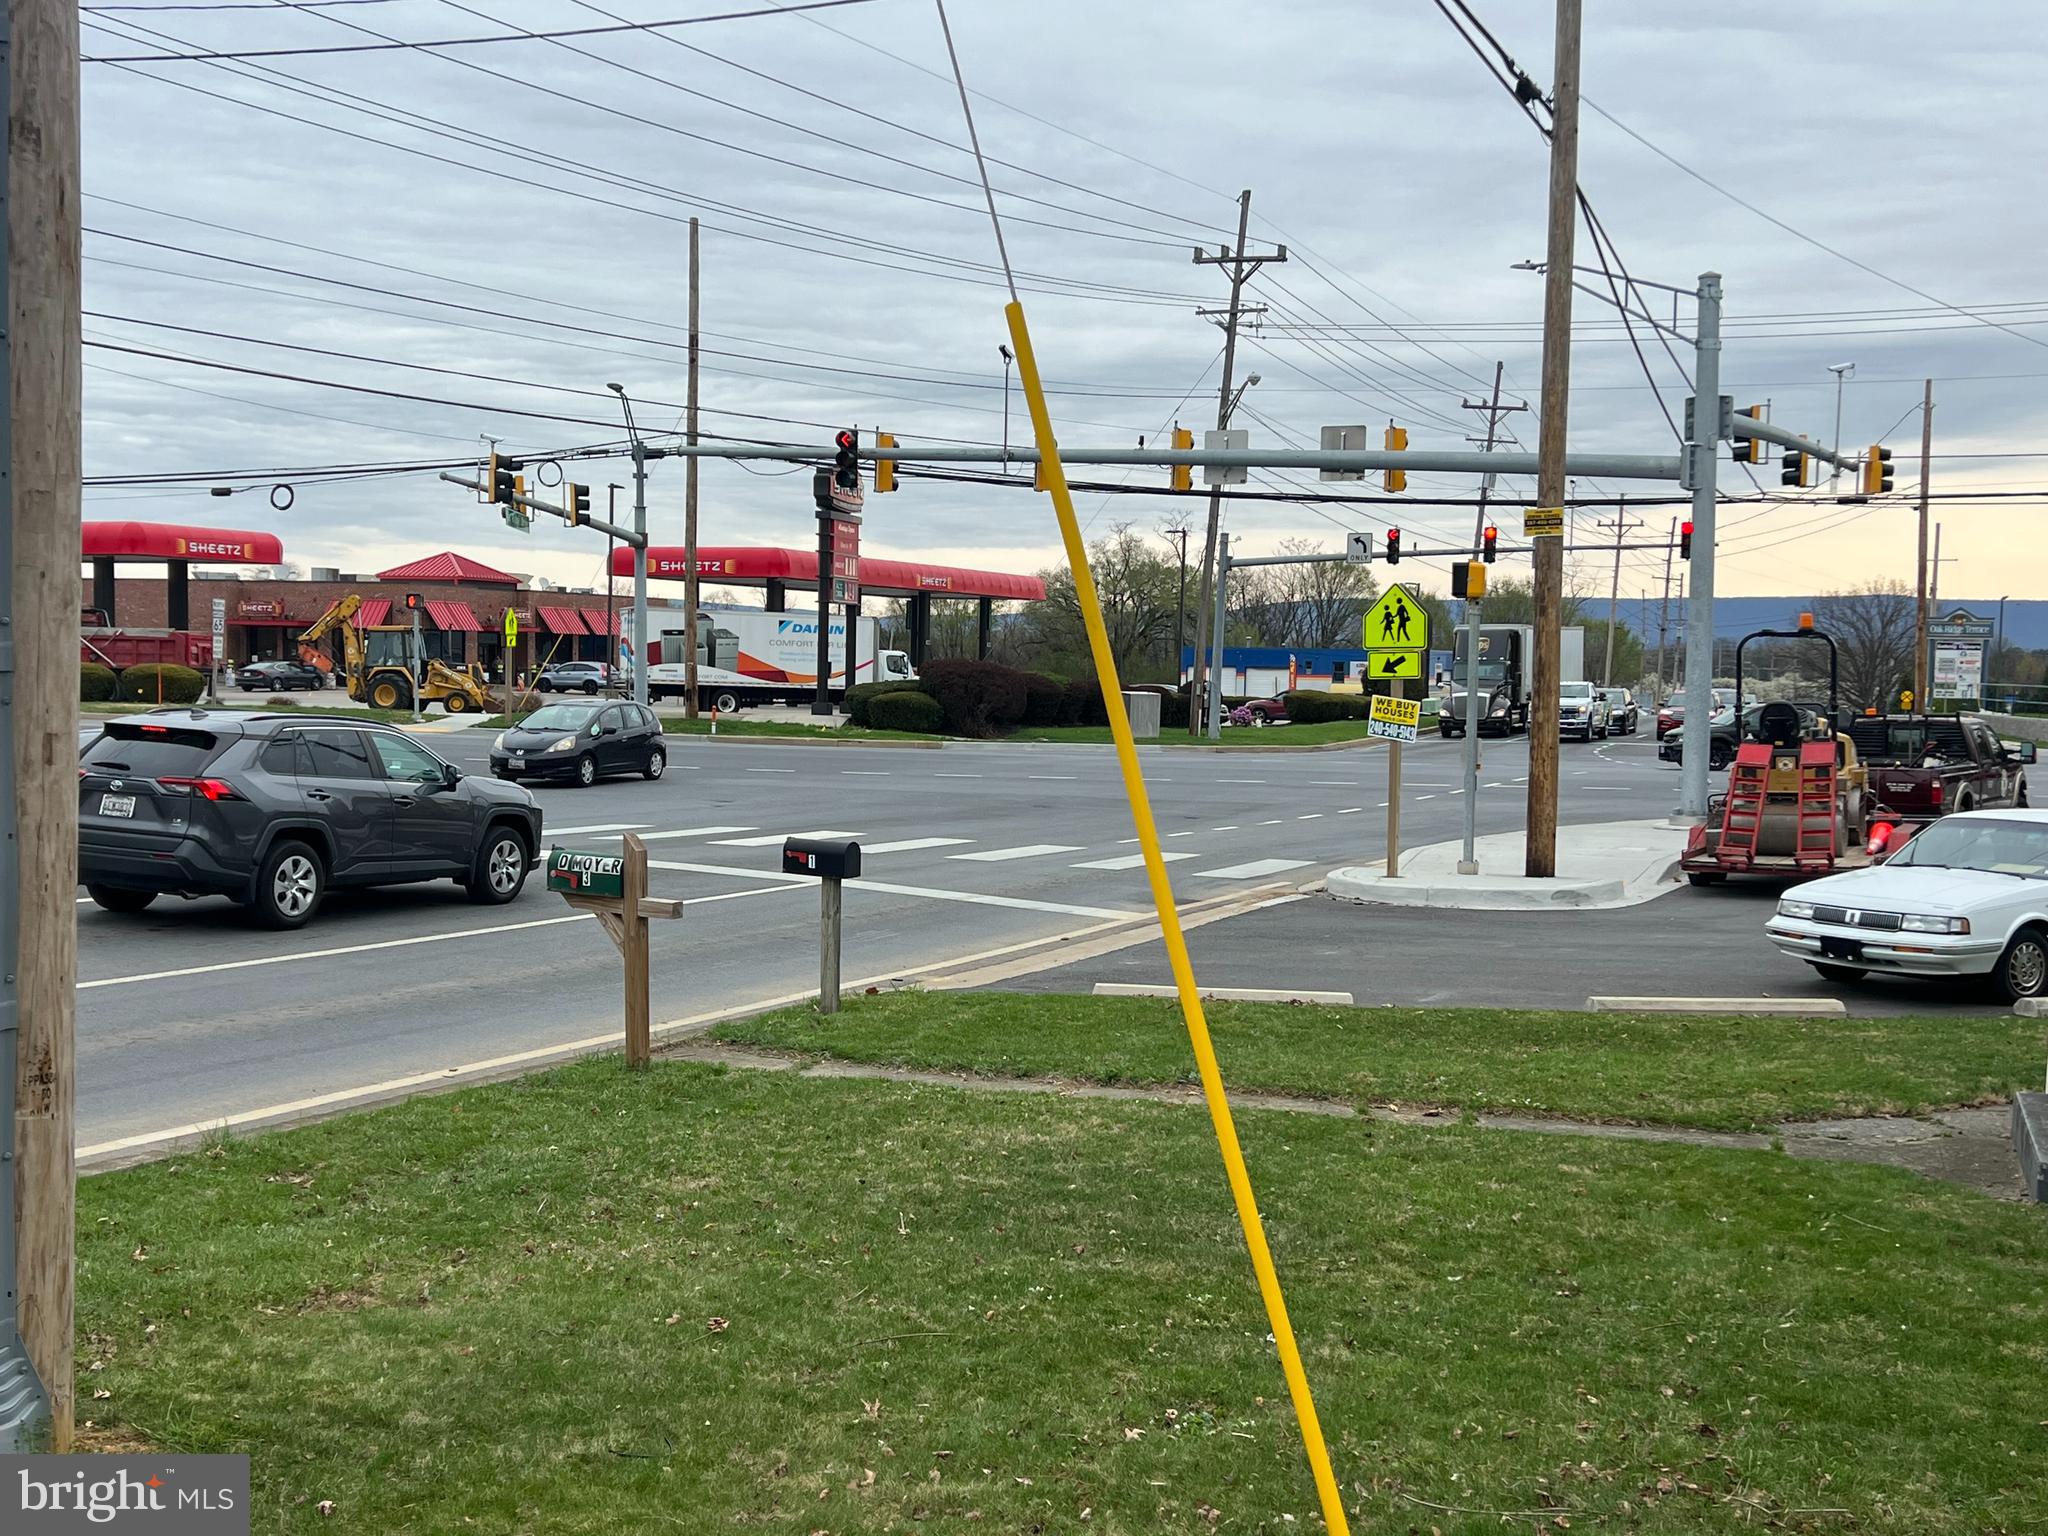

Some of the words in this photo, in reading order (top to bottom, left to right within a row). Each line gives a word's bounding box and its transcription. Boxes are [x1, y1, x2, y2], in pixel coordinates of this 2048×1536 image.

[189, 542, 241, 556] SHEETZ
[1350, 554, 1369, 562] ONLY
[921, 576, 946, 587] SHEETZ
[242, 604, 273, 613] SHEETZ
[792, 623, 844, 635] DAIIN
[769, 639, 814, 648] COMFORT
[1376, 697, 1392, 707] WE
[1396, 700, 1416, 711] BUY
[1375, 706, 1415, 720] HOUSES
[559, 855, 568, 869] D
[572, 856, 620, 874] MOYER
